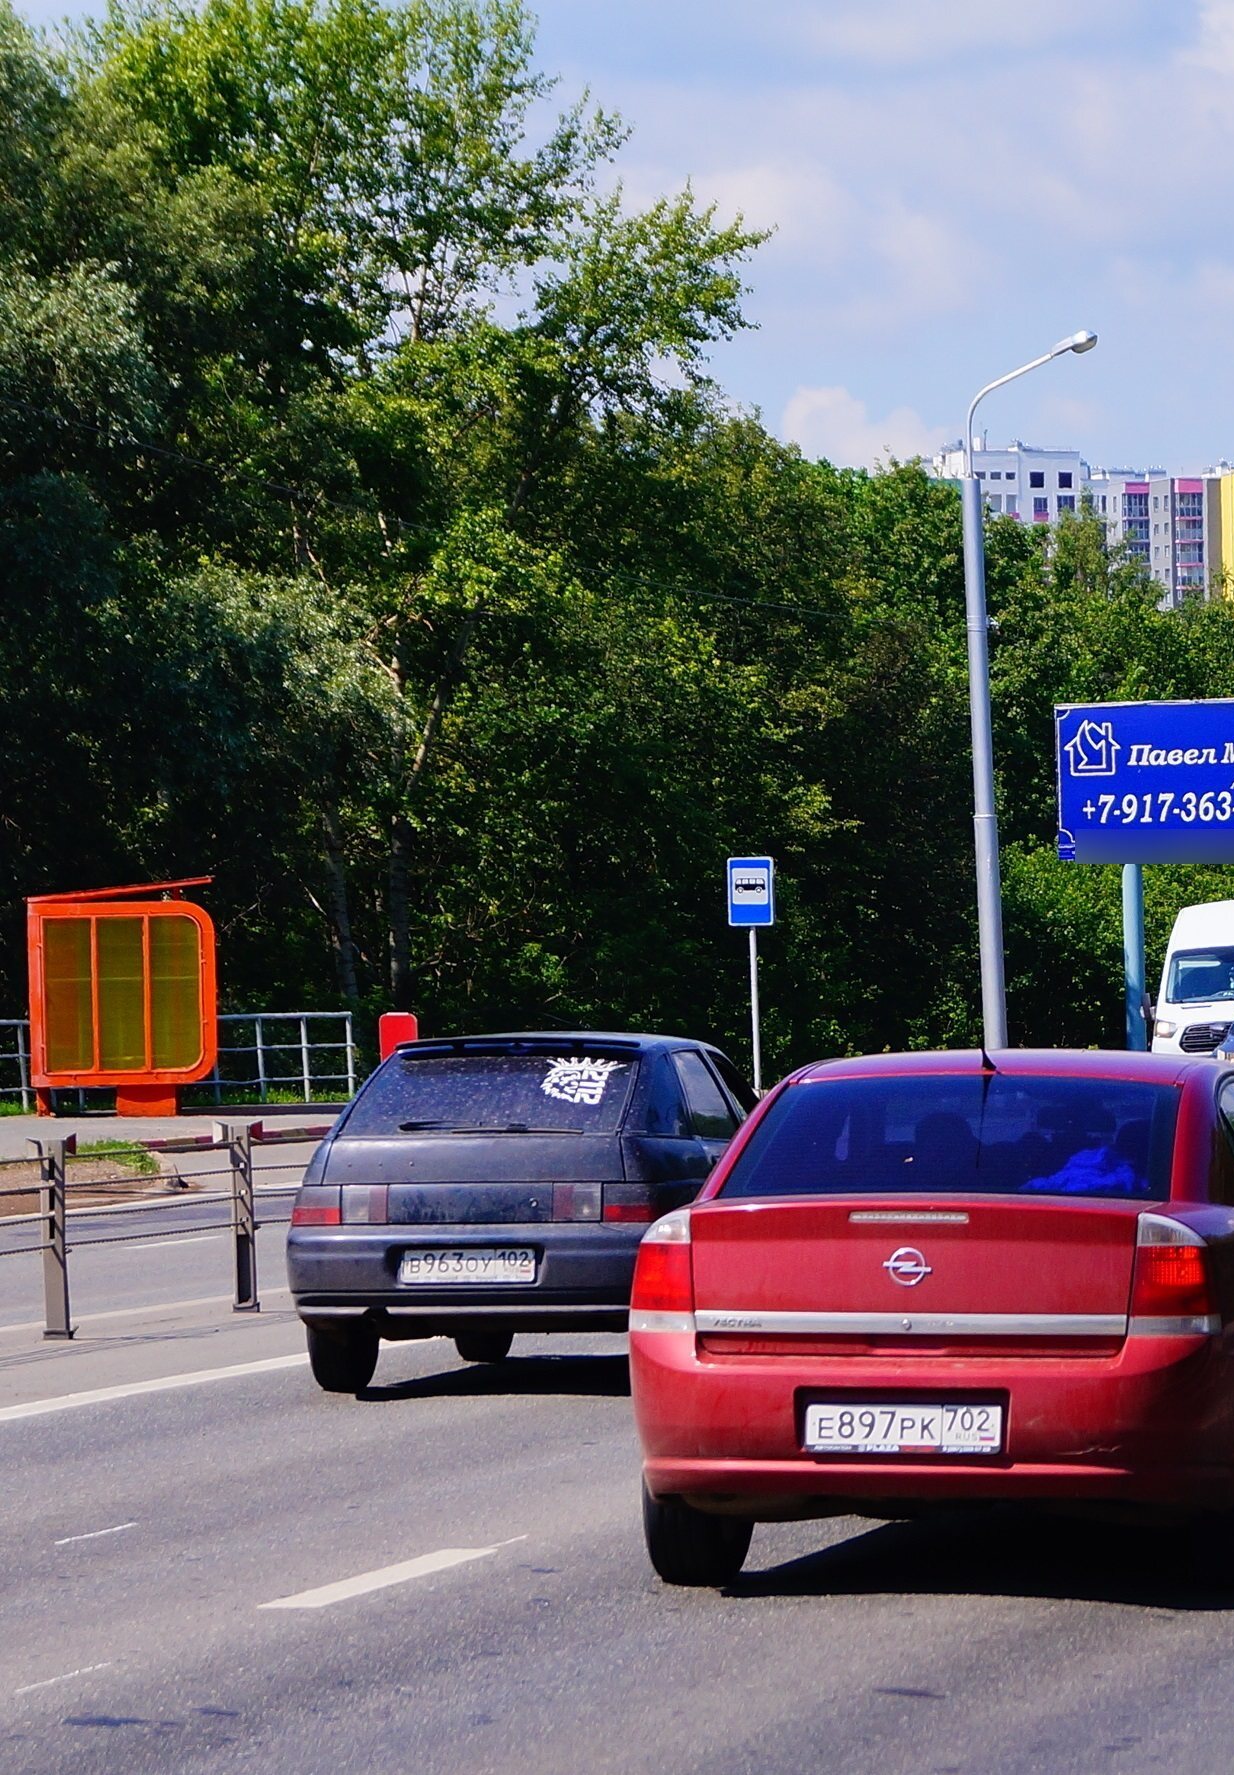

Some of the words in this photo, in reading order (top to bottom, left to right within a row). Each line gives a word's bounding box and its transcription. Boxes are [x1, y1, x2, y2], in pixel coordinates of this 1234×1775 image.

[1127, 744, 1218, 766] Павел
[497, 1251, 529, 1268] 102
[945, 1407, 990, 1433] 702
[954, 1432, 978, 1441] RUS
